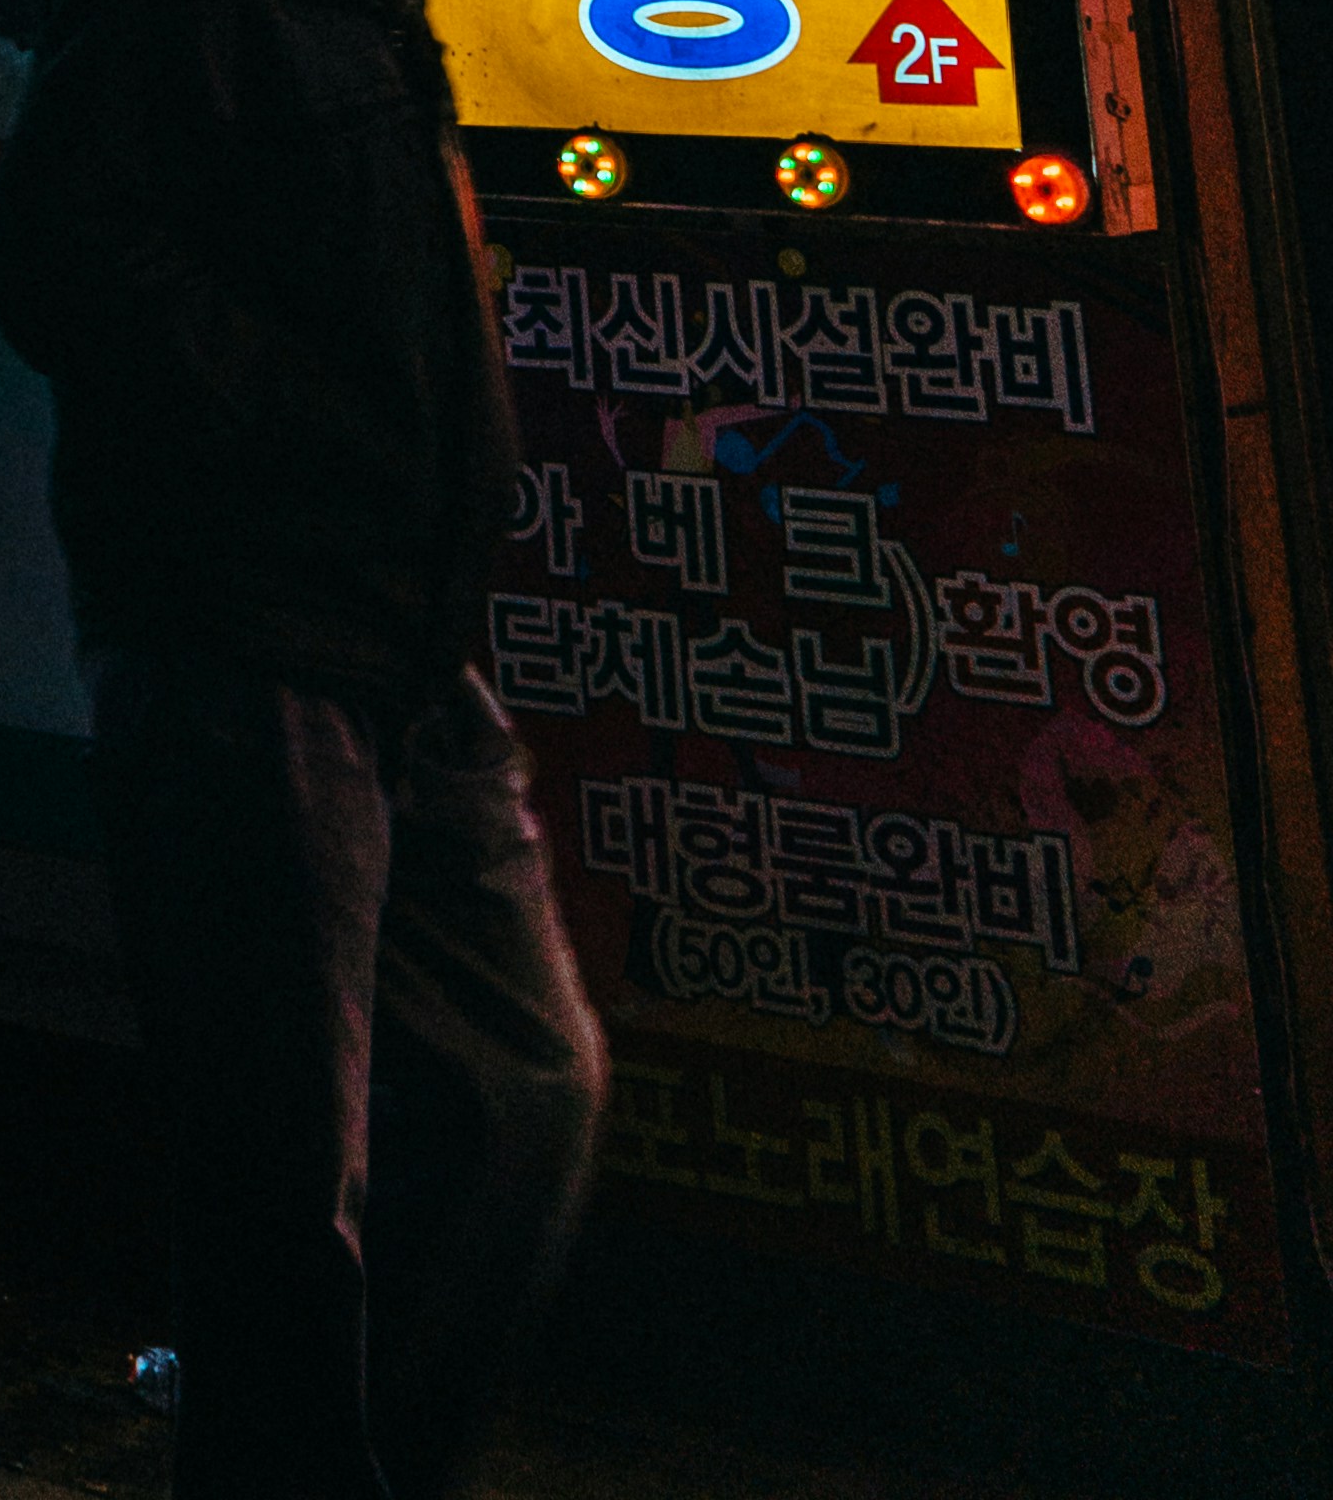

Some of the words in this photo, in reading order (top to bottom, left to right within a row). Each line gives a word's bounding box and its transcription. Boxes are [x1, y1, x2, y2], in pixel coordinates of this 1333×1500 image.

[889, 21, 961, 87] 2F
[501, 264, 1096, 434] 최신시설완비
[935, 570, 1168, 729] 환영
[579, 776, 1082, 973] 대형룸완비
